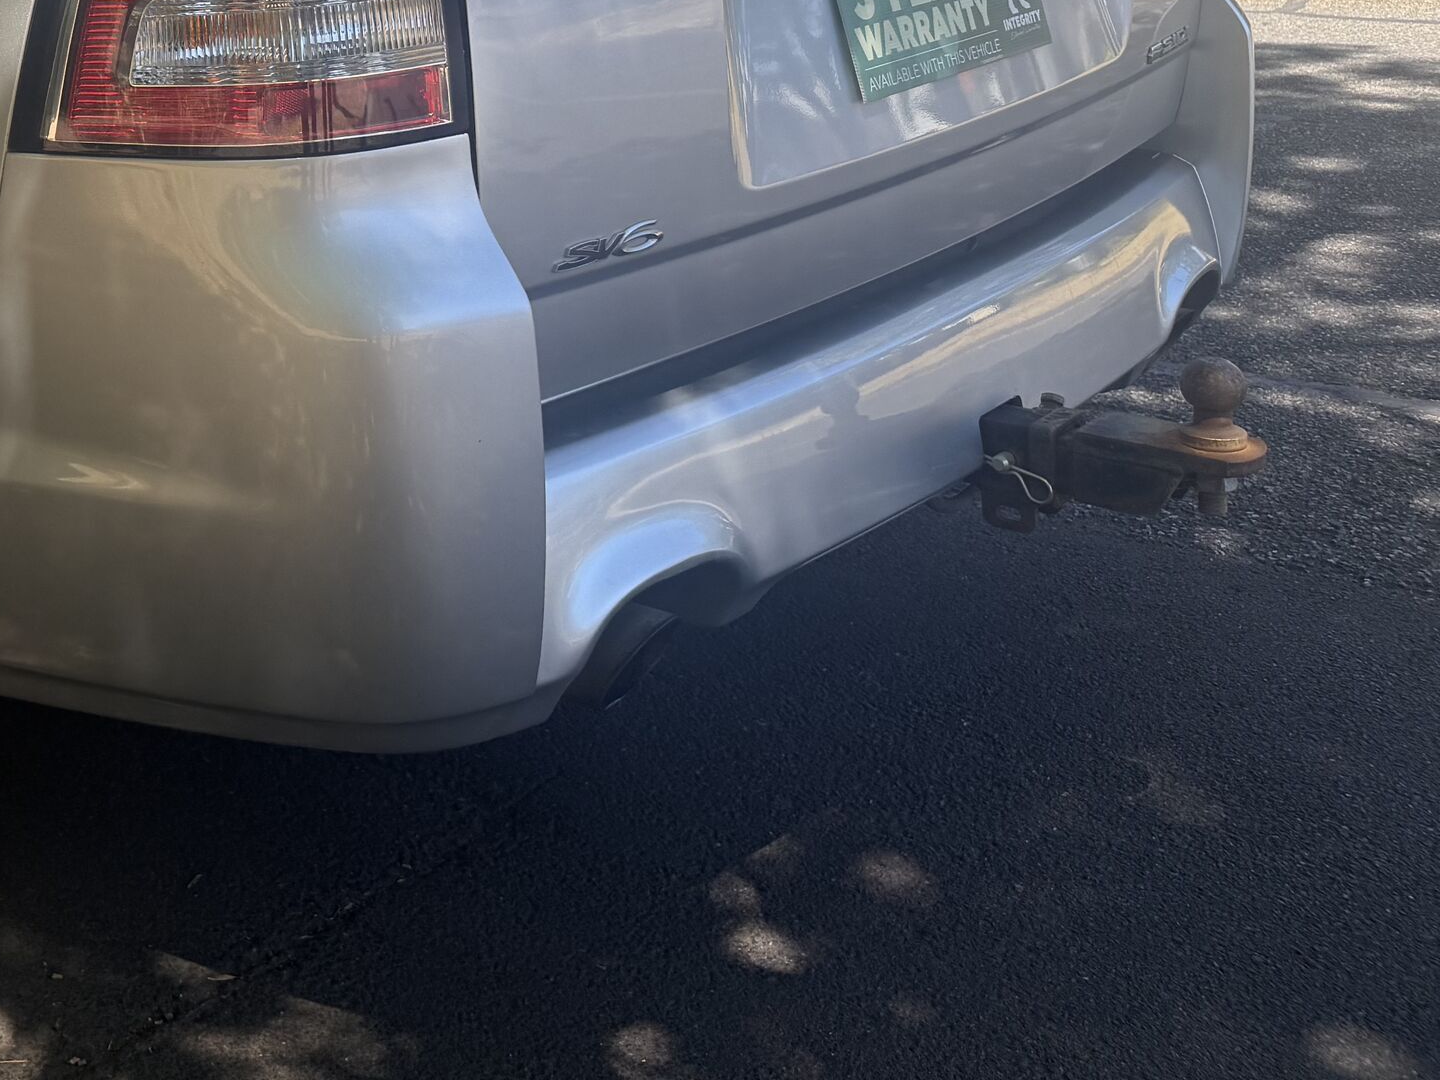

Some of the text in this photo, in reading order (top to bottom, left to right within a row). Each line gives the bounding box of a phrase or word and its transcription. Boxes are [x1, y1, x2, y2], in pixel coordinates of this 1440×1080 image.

[1002, 9, 1041, 31] INTEGRITY
[869, 63, 921, 92] AVAILABLE
[921, 56, 945, 75] WITH
[945, 50, 966, 68] THIS
[966, 38, 1002, 61] VEHICLE
[551, 219, 664, 273] SV6
